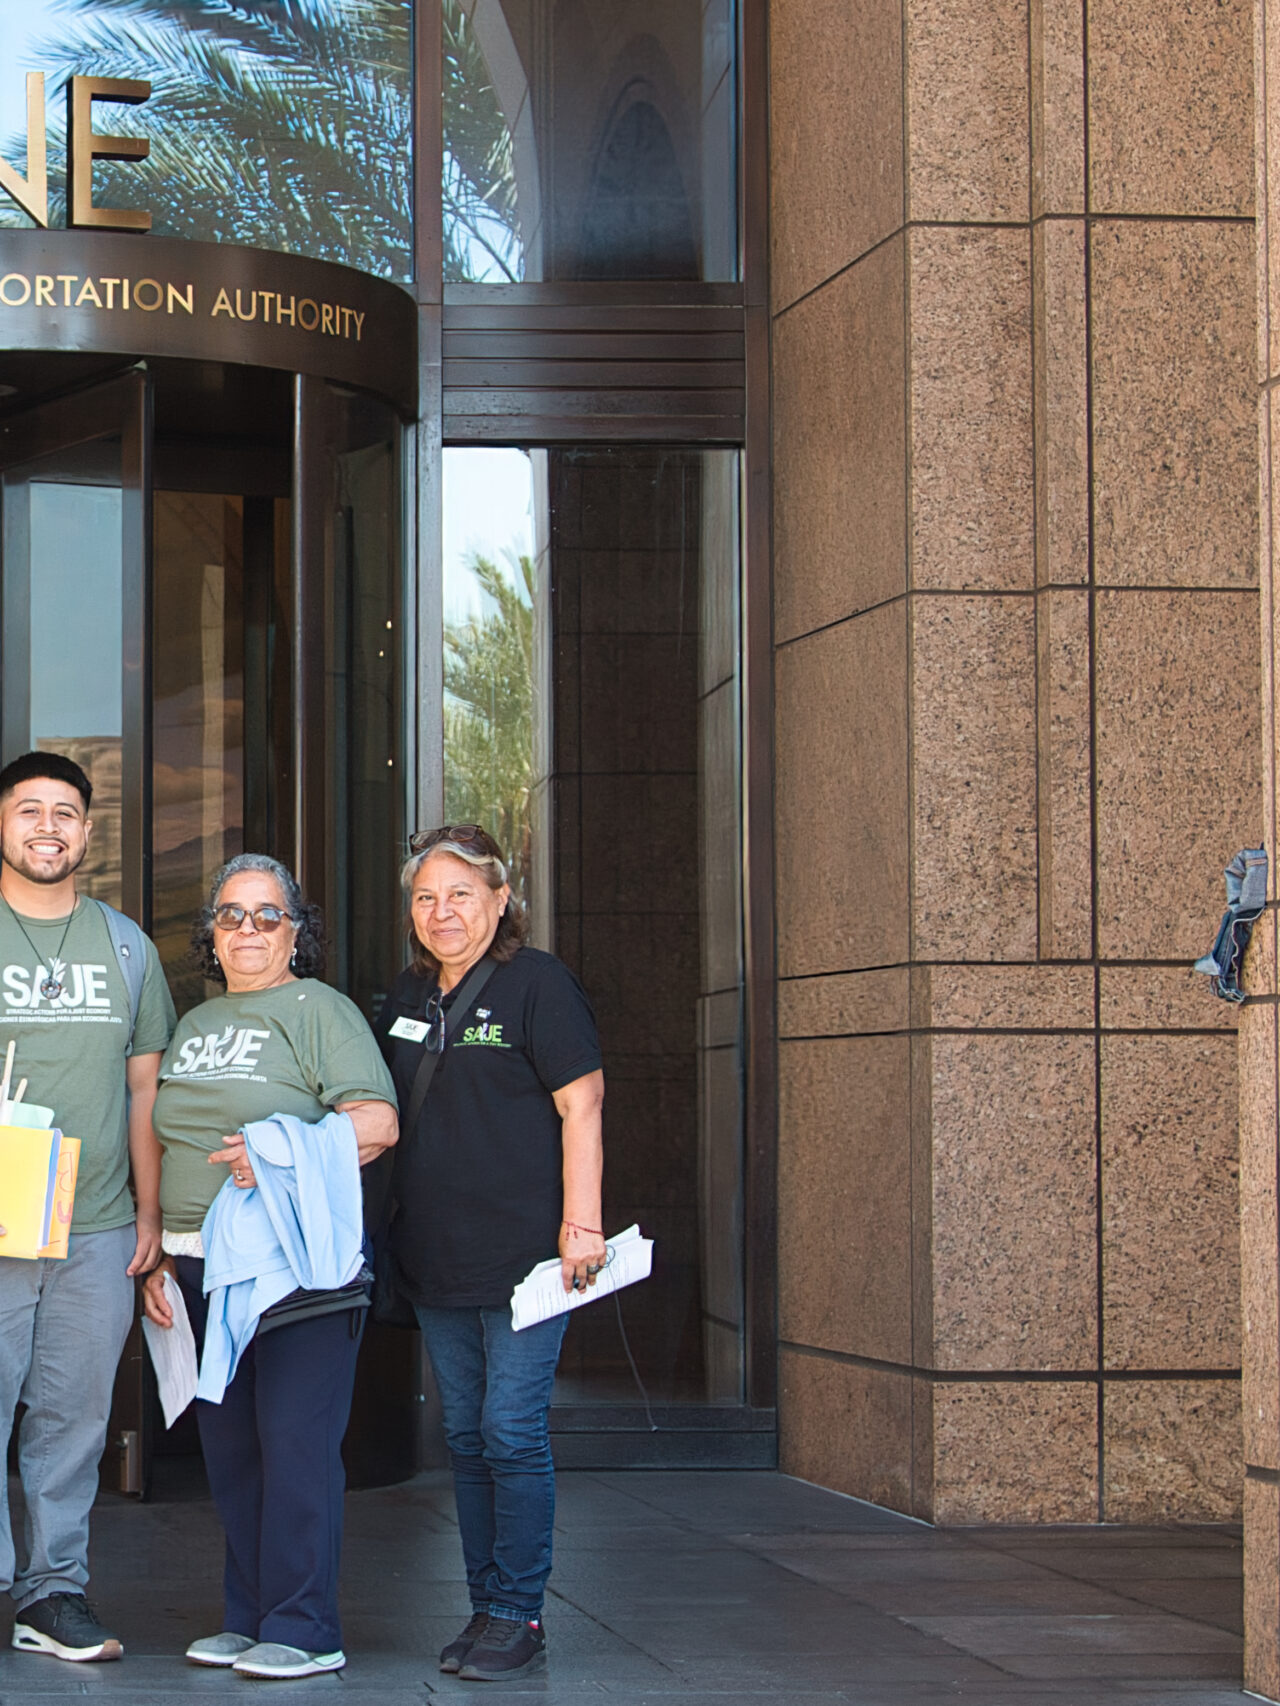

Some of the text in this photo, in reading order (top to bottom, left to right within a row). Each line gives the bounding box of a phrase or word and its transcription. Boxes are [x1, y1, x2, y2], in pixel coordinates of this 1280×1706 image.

[211, 287, 365, 341] AUTHORITY
[2, 962, 111, 1009] SAJE
[173, 1028, 271, 1074] SAJE
[463, 1024, 503, 1042] SAJE
